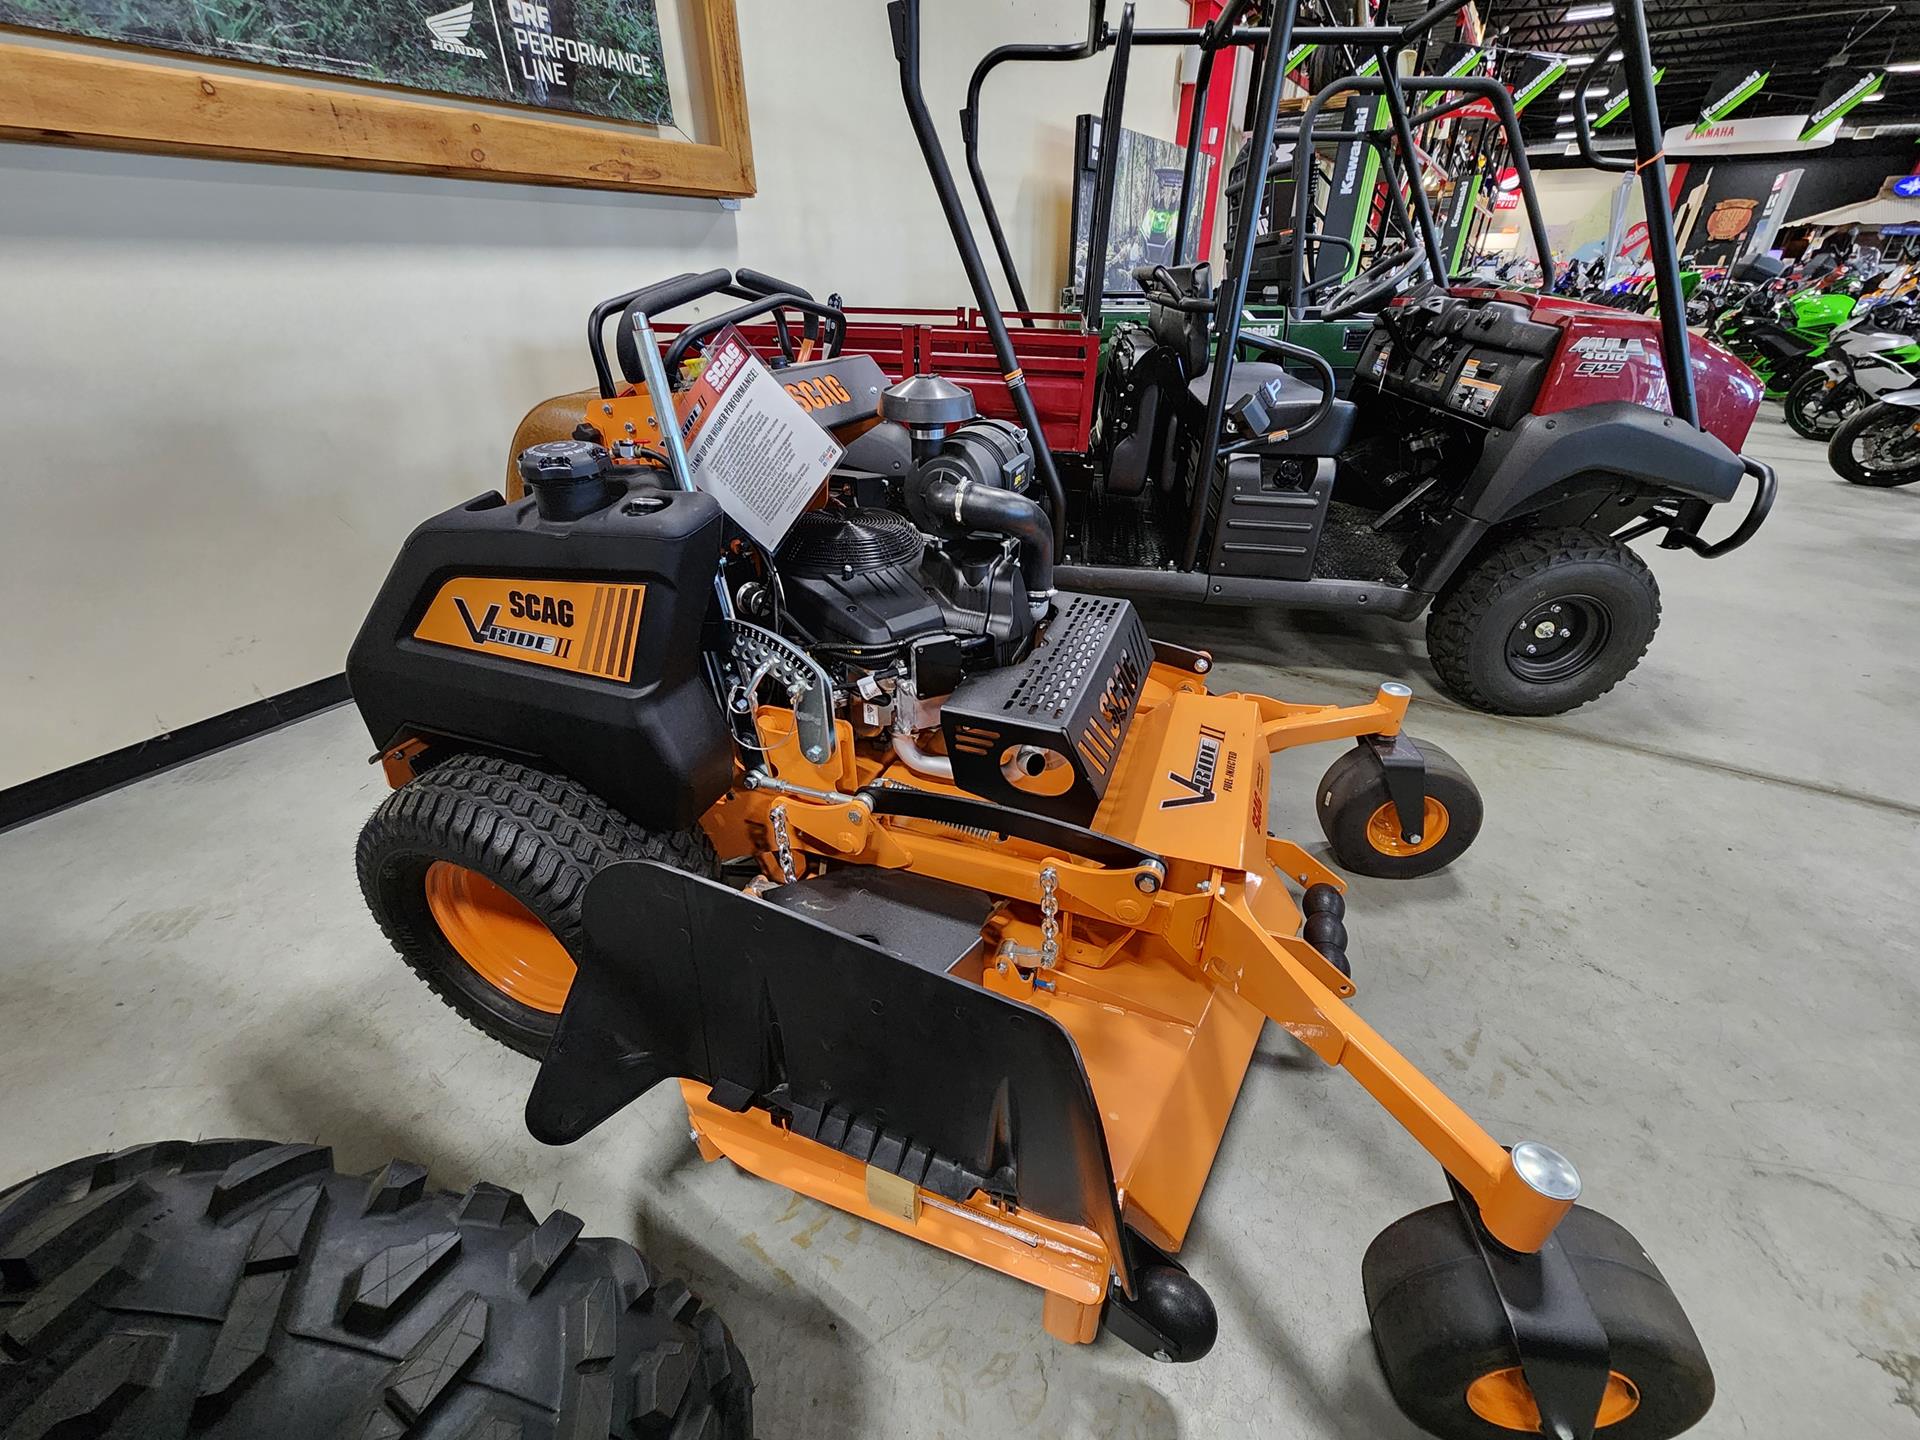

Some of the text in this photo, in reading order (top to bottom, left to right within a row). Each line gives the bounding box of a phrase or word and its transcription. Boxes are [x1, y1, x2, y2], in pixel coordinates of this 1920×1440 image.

[507, 0, 550, 29] CRF
[431, 39, 489, 60] HONDA
[513, 27, 653, 78] PERFORMANCE
[520, 56, 568, 87] LINE
[1514, 58, 1562, 101] Kawasaki
[1702, 70, 1760, 118] Kawasaki
[1811, 72, 1875, 123] Kawasaki
[1340, 107, 1369, 195] Kawaaki
[1451, 181, 1469, 228] Kawasaki
[705, 342, 741, 388] SCAG
[784, 374, 851, 414] SCAG
[710, 413, 729, 439] HIGHER
[509, 590, 575, 629] SCAG
[1223, 751, 1238, 792] FUEL-INJECTED
